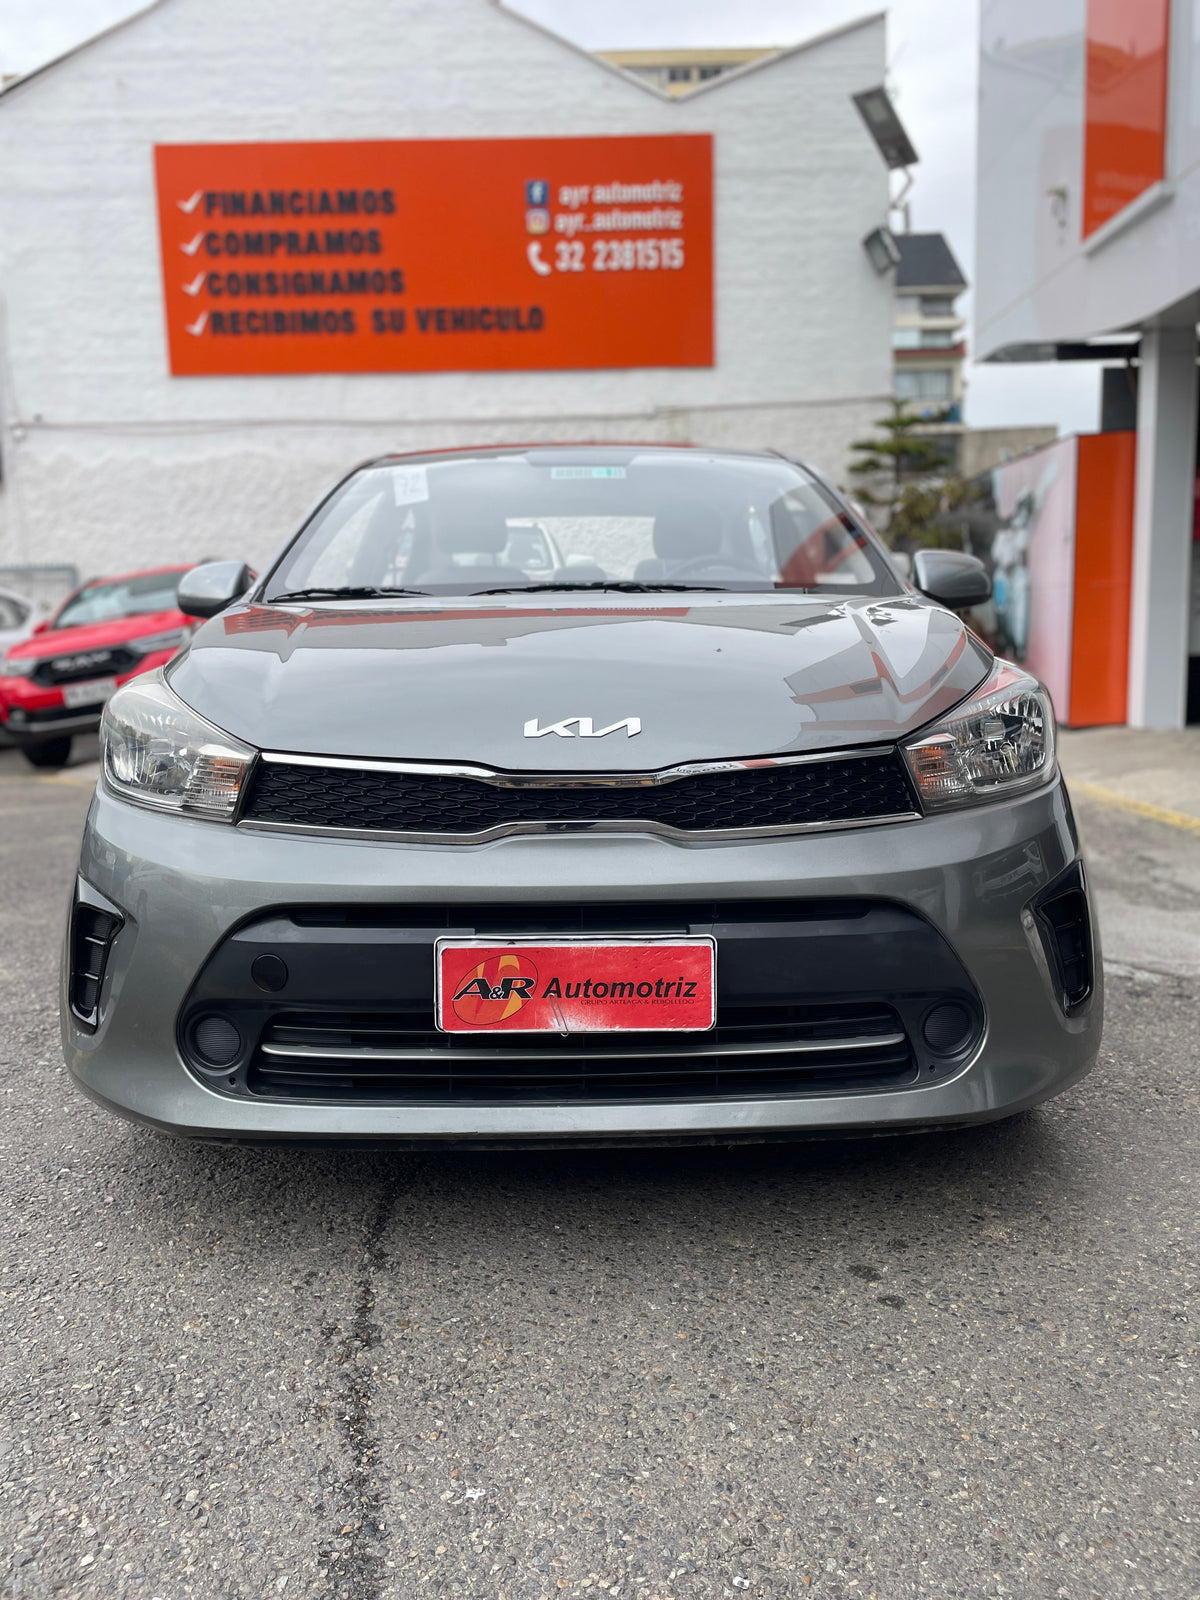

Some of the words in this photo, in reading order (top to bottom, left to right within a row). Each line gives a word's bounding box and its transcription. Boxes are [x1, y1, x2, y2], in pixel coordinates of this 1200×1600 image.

[204, 189, 396, 216] FINANCIAMOS
[559, 185, 590, 210] ayr
[592, 179, 683, 204] automotriz
[205, 230, 381, 256] COMPRAMOS
[555, 240, 585, 272] 32
[592, 237, 684, 271] 2381515
[206, 269, 404, 296] CONSIGNAMOS
[211, 309, 355, 335] RECIBIMOS
[372, 308, 405, 333] SU
[415, 306, 544, 332] VEHICULO
[453, 977, 534, 1000] A&R
[542, 976, 698, 998] Automotriz
